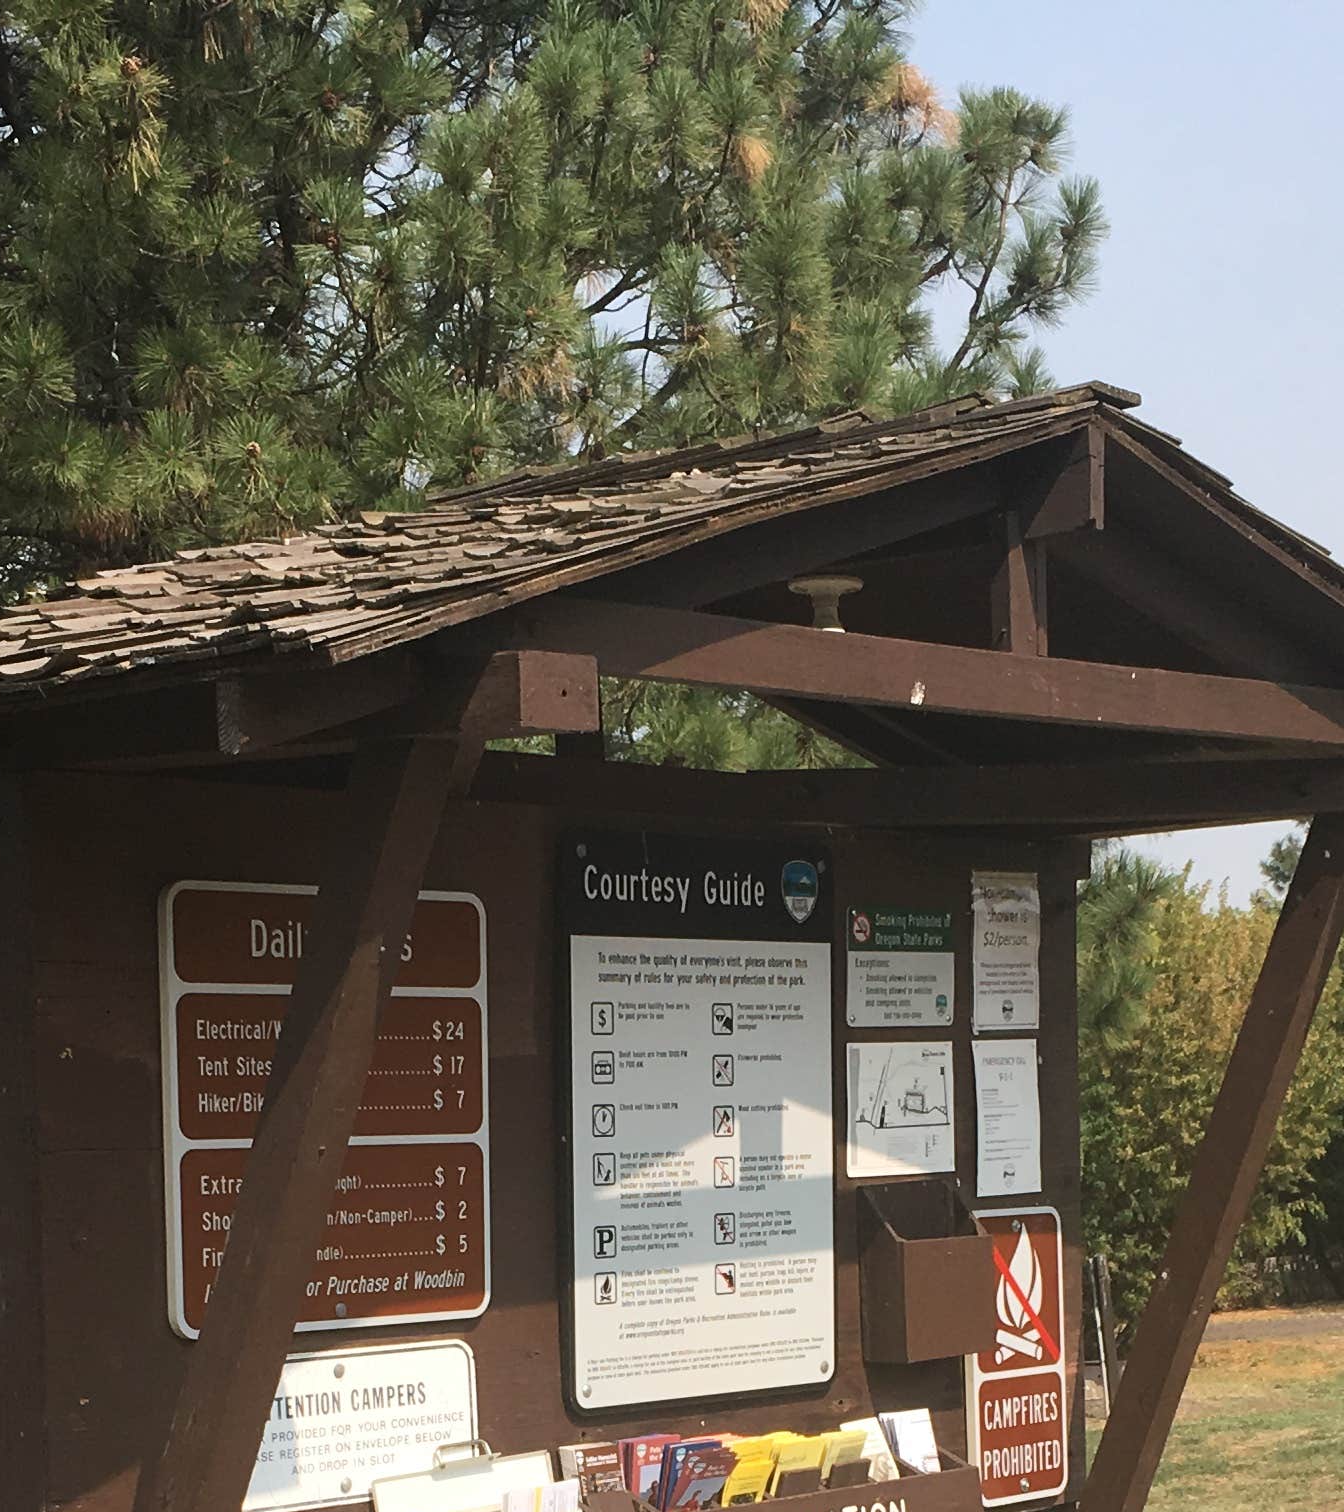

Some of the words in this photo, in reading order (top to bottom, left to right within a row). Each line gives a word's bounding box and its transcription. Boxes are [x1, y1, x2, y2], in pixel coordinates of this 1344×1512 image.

[584, 864, 690, 914] Courtesy
[704, 870, 765, 907] Guide
[250, 919, 309, 959] Dail
[197, 1056, 229, 1076] Tent
[236, 1056, 273, 1076] Sites
[455, 1090, 465, 1109] 7
[200, 1175, 244, 1195] Extra
[334, 1176, 362, 1195] ight)
[457, 1166, 467, 1185] 7
[458, 1200, 468, 1220] 2
[459, 1234, 468, 1253] 5
[306, 1280, 323, 1297] or
[326, 1275, 391, 1296] Purchase
[394, 1272, 409, 1292] at
[414, 1269, 466, 1291] Woodbin
[273, 1391, 342, 1420] TENTION
[350, 1382, 427, 1412] CAMPERS
[984, 1391, 1058, 1431] CAMPFIRES
[271, 1427, 327, 1443] PROVIDED
[331, 1424, 352, 1438] FOR
[358, 1420, 387, 1434] YOUR
[391, 1411, 465, 1429] CONVENIENCE
[279, 1444, 331, 1460] REGISTER
[335, 1441, 351, 1453] ON
[356, 1434, 410, 1450] ENVELOPE
[415, 1429, 453, 1444] BELOW
[291, 1461, 314, 1475] AND
[319, 1458, 349, 1472] DROP
[354, 1455, 366, 1468] IN
[369, 1452, 396, 1465] SLOT
[983, 1439, 1061, 1481] PROHIBITED
